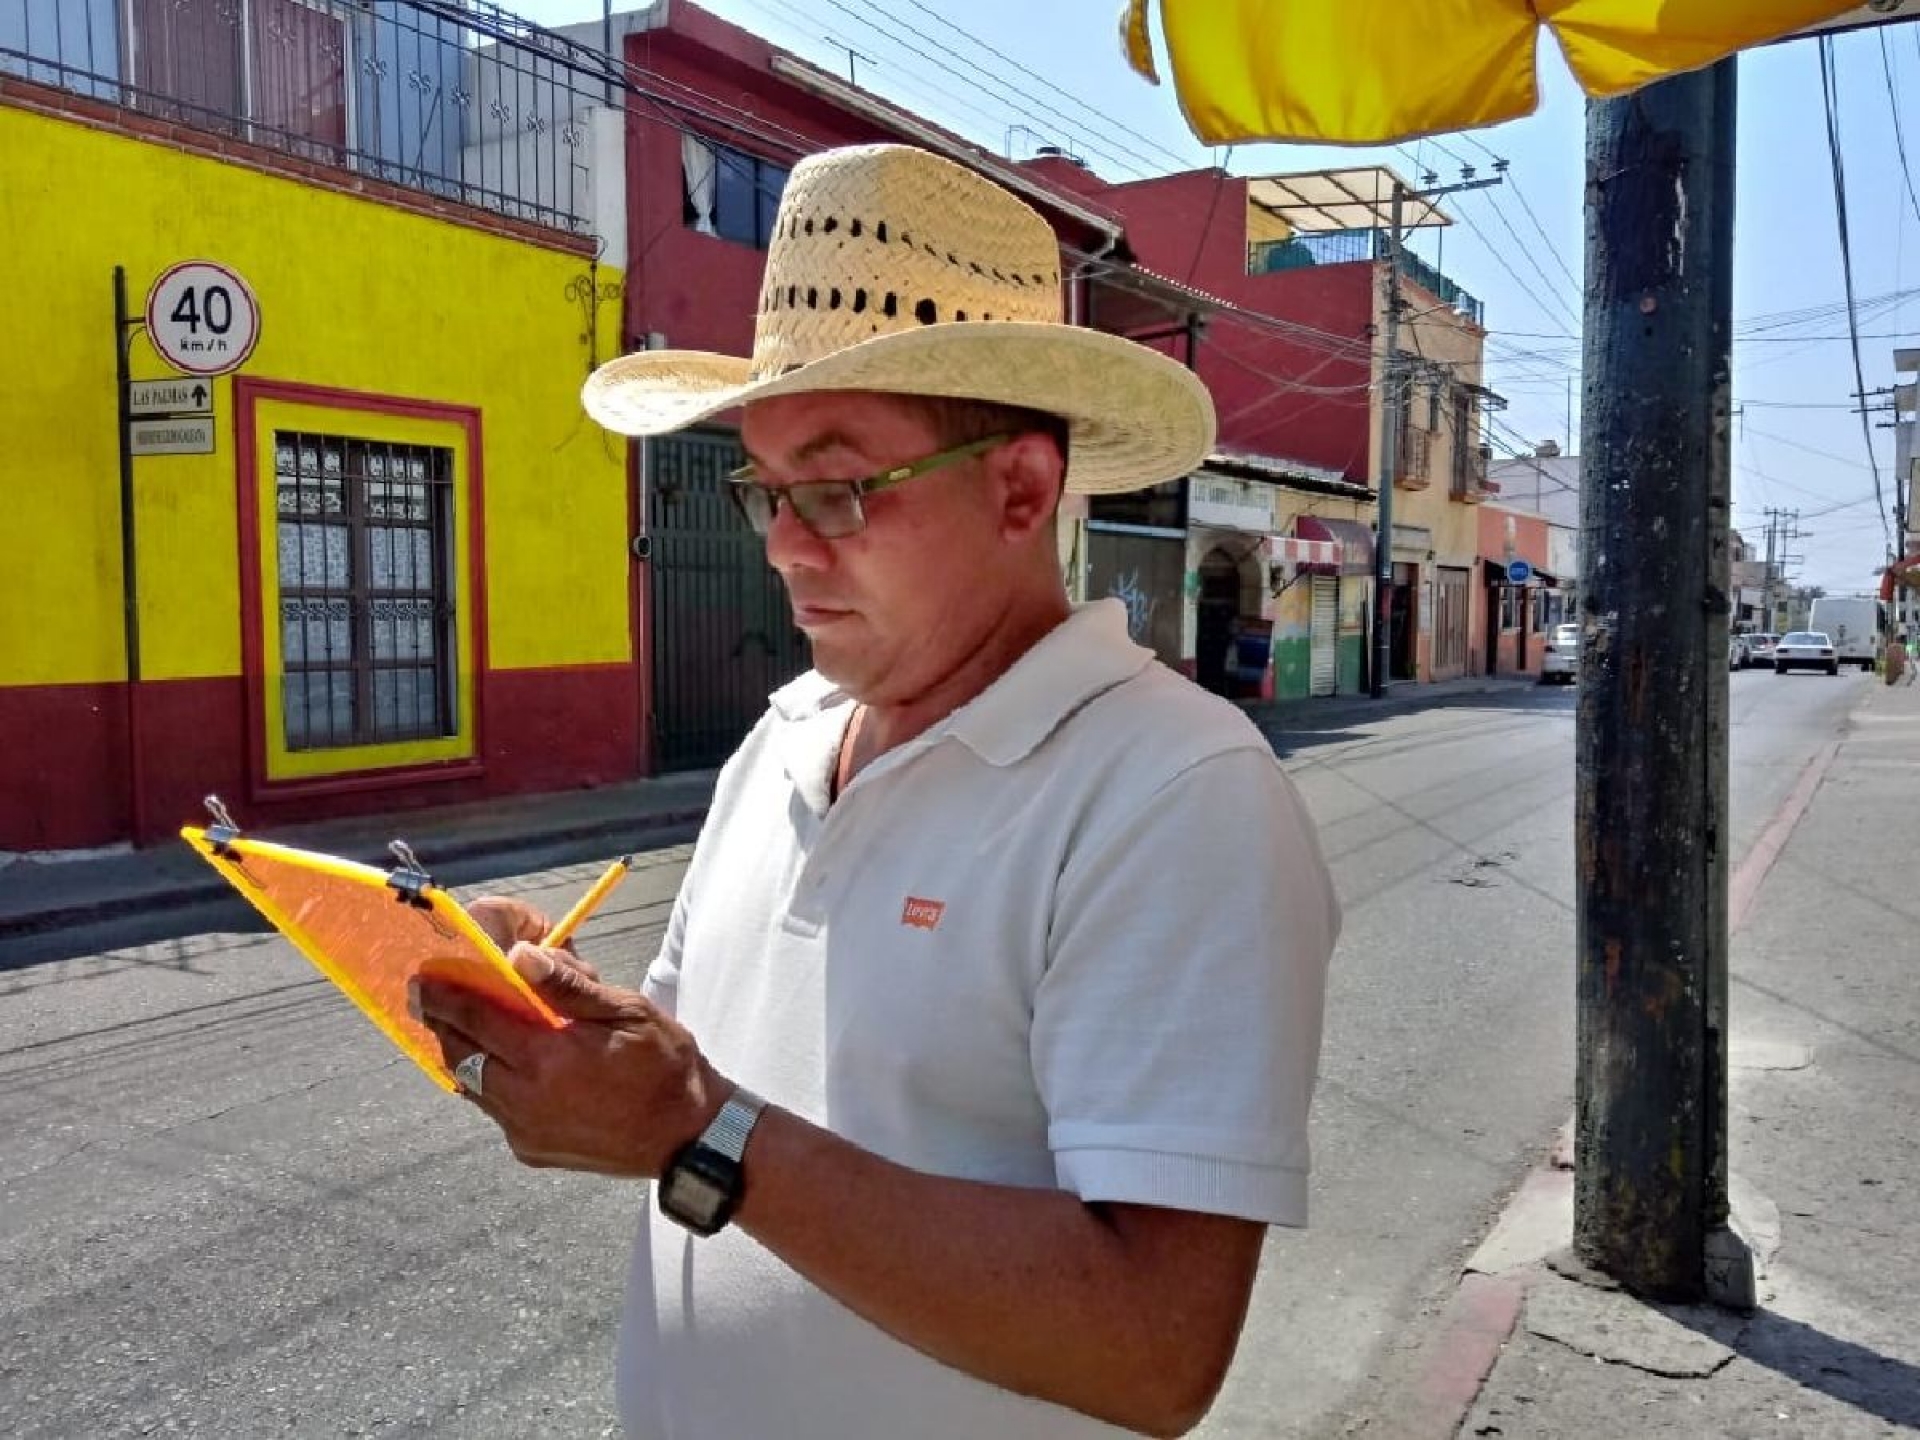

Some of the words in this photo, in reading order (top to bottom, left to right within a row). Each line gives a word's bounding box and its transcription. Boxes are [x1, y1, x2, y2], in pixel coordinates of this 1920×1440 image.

[171, 285, 233, 334] 40
[180, 339, 227, 351] km/h
[133, 389, 149, 406] LAS
[152, 384, 188, 406] PALMAS
